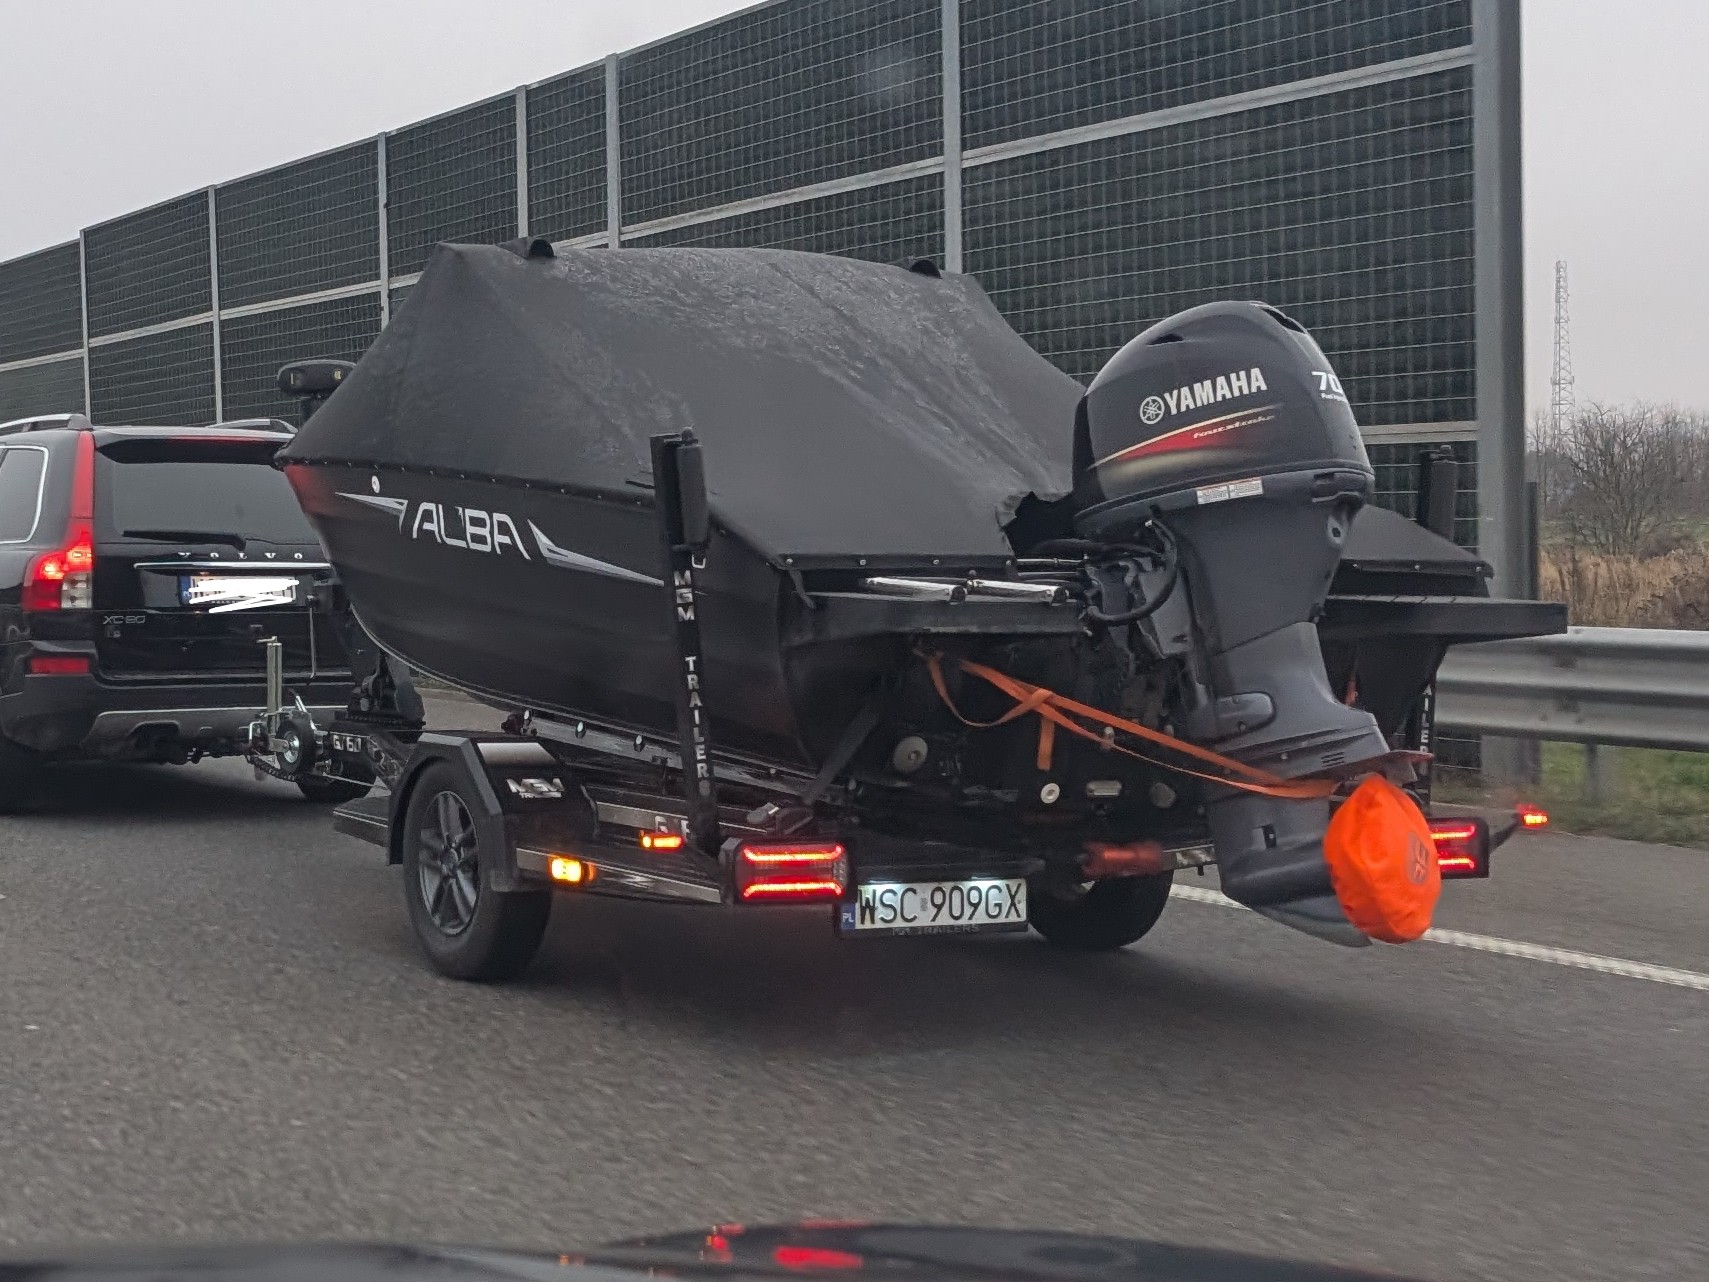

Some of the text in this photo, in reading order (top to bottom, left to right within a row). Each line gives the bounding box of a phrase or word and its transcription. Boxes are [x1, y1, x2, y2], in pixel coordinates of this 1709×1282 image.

[1163, 367, 1267, 415] YAMAHA
[1311, 371, 1345, 394] 70
[177, 551, 303, 560] VOLVO
[673, 570, 695, 621] MGM
[842, 912, 855, 923] PL
[858, 882, 1022, 925] WSC 909GX
